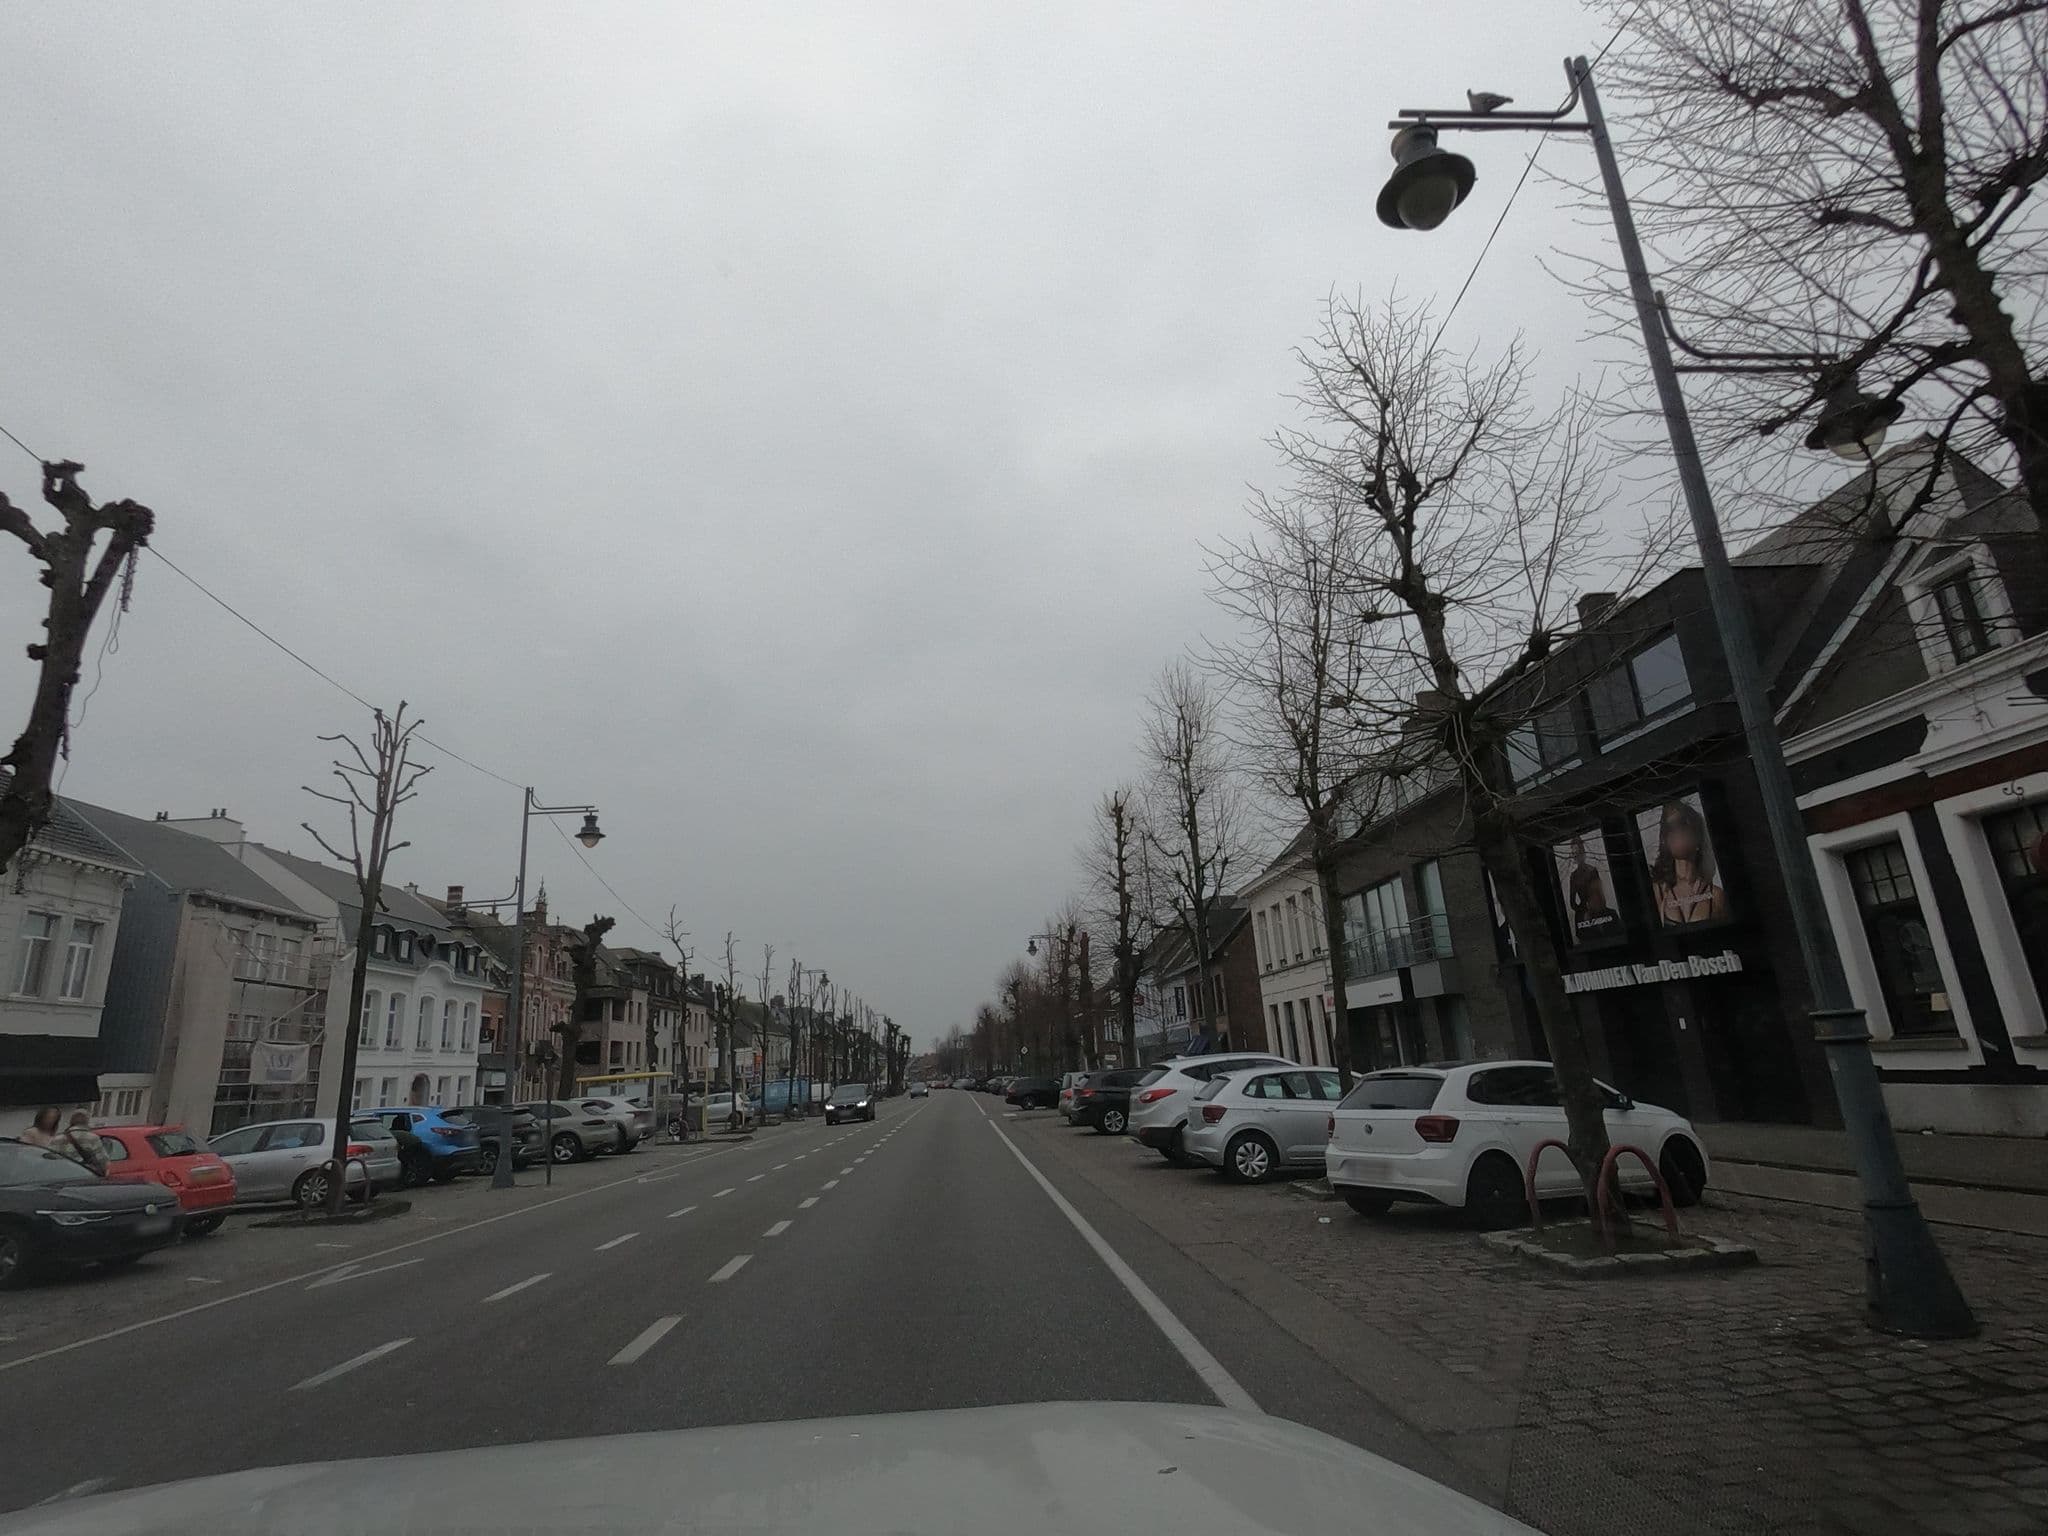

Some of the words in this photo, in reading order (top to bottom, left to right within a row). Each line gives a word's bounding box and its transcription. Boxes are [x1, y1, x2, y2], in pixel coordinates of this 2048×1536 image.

[1632, 963, 1660, 984] Van
[1658, 960, 1689, 981] Den
[1687, 950, 1742, 977] Bosch
